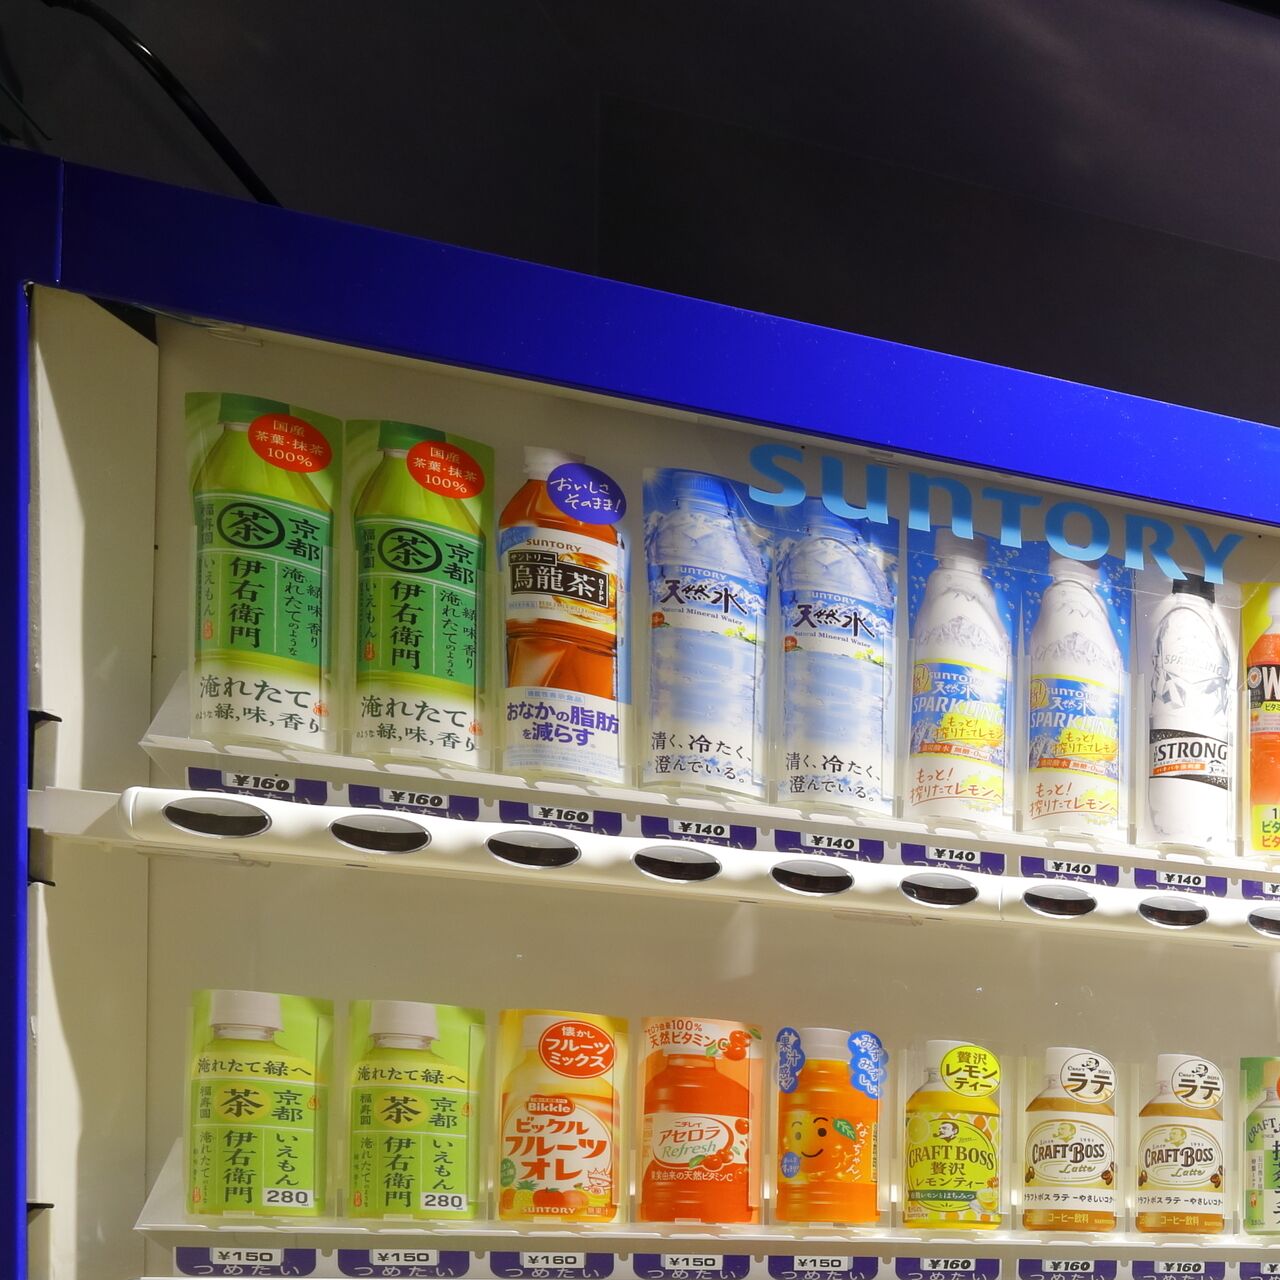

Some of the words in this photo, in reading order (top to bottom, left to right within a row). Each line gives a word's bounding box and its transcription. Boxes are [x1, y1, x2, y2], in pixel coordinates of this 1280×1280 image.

[273, 420, 305, 437] 国産
[266, 447, 312, 467] 100%
[551, 478, 609, 495] おいしさ
[514, 565, 596, 597] 烏龍茶
[660, 579, 748, 615] 天然水
[685, 608, 718, 621] Mineral
[720, 614, 743, 626] Water
[793, 604, 876, 638] 天然水
[506, 700, 620, 733] おなかの脂肪
[1158, 741, 1228, 761] STRONG
[234, 774, 290, 791] ¥160
[388, 790, 444, 807] ¥160
[539, 807, 590, 823] ¥160
[679, 822, 725, 836] ¥140
[810, 835, 855, 850] ¥140
[935, 849, 975, 861] ¥140
[546, 1038, 609, 1053] フルーツ
[550, 1054, 605, 1069] ミックス
[957, 1052, 987, 1064] 贅沢
[945, 1065, 997, 1079] レモン
[1068, 1073, 1113, 1094] ラテ
[1178, 1079, 1220, 1099] ラテ
[221, 1089, 263, 1117] 茶
[271, 1089, 304, 1122] 京都
[380, 1096, 421, 1124] 茶
[528, 1102, 570, 1113] Bikkle
[428, 1096, 457, 1129] 京都
[516, 1117, 589, 1135] ビックル
[659, 1126, 721, 1146] アセロラ
[505, 1136, 607, 1158] フルーツ
[662, 1141, 716, 1158] Refresh
[1032, 1144, 1069, 1166] CRAFT
[1069, 1143, 1104, 1163] BOSS
[223, 1130, 258, 1204] 伊右衛門
[276, 1132, 299, 1186] いえもん
[432, 1139, 454, 1190] いえもん
[908, 1147, 953, 1169] CRAFT
[956, 1147, 994, 1169] BOSS
[383, 1136, 415, 1207] 伊右衛門
[520, 1159, 583, 1180] オレ
[930, 1164, 966, 1176] 贅沢
[916, 1177, 985, 1188] レモンティー
[267, 1190, 308, 1204] 280
[218, 1250, 273, 1262] ¥150
[377, 1252, 429, 1262] ¥150
[669, 1257, 715, 1267] ¥150
[798, 1259, 842, 1268] ¥150
